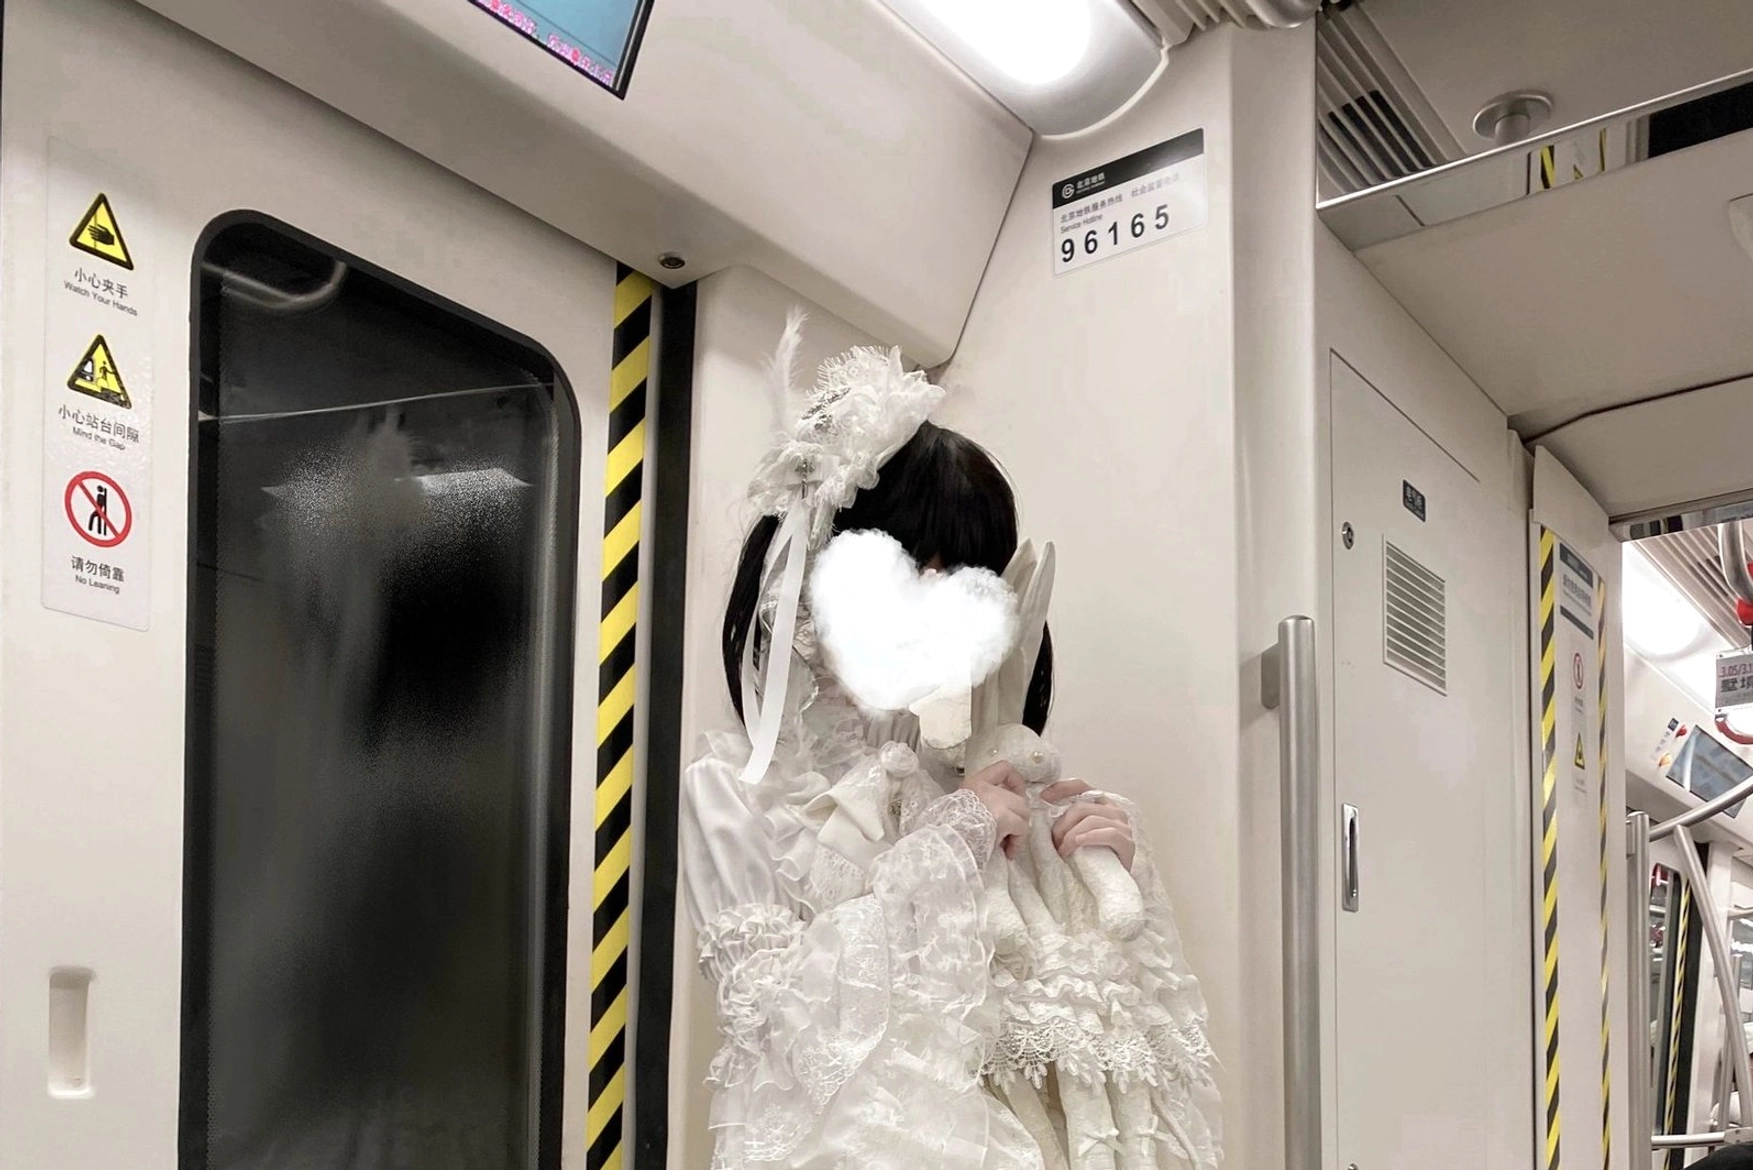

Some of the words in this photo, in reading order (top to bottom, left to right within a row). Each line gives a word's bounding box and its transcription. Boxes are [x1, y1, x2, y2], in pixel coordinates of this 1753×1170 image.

[1060, 221, 1082, 234] Service
[1082, 213, 1103, 225] Hotline
[1061, 203, 1169, 263] 96165
[74, 267, 129, 299] 小心夹手
[63, 280, 90, 297] Watch
[91, 291, 111, 305] Your
[112, 299, 138, 317] Hands
[58, 404, 140, 443] 小心站台间隙
[72, 426, 93, 440] Mind
[108, 438, 126, 451] Gap
[71, 555, 125, 582] 请勿倚靠
[75, 574, 87, 585] No
[88, 578, 120, 595] Leaning
